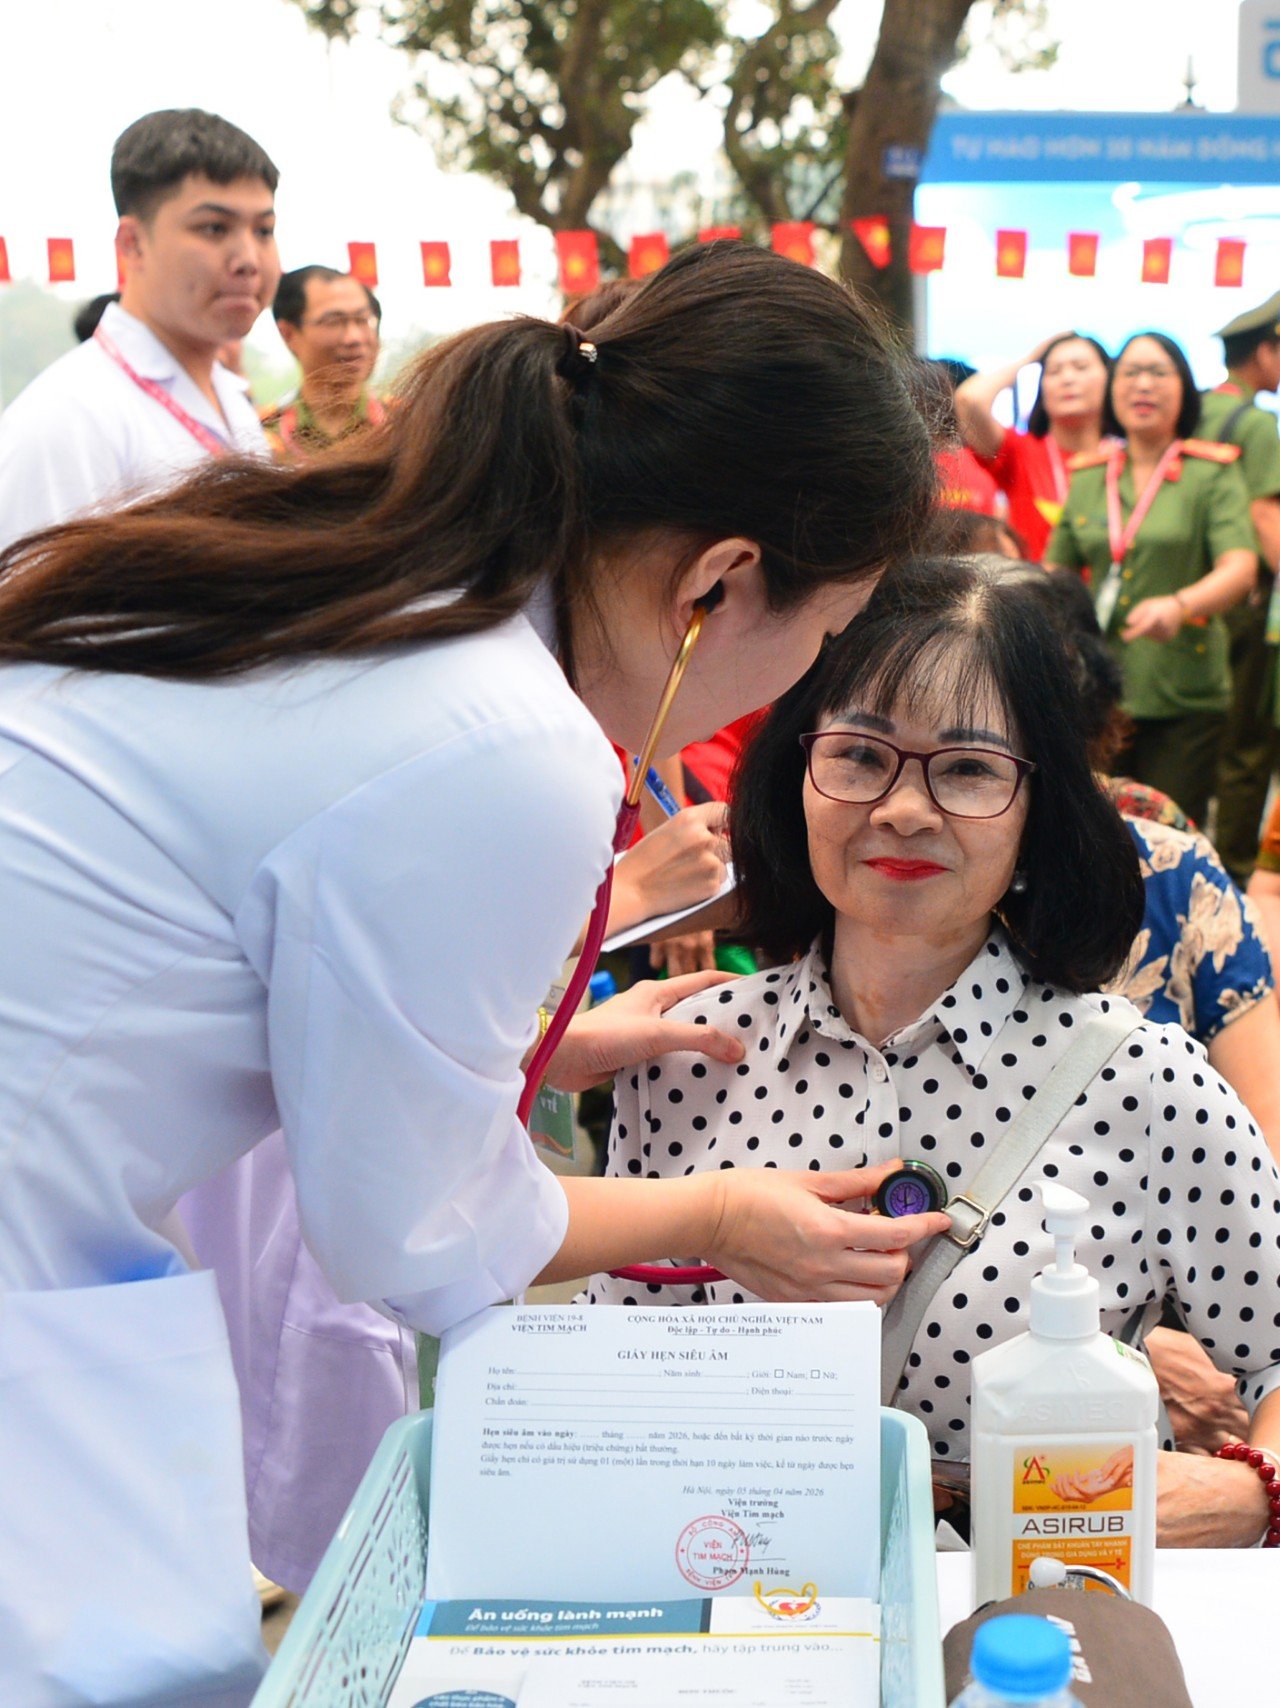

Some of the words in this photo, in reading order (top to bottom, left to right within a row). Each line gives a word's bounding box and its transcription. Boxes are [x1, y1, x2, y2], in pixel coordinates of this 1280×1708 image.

[627, 1315, 655, 1326] CỘNG
[698, 1315, 716, 1325] HỘI
[775, 1316, 799, 1326] VIỆT
[801, 1317, 823, 1325] NAM
[536, 1324, 555, 1332] TIM
[558, 1324, 587, 1333] MẠCH
[651, 1351, 675, 1362] HẸN
[679, 1350, 705, 1360] SIÊU
[709, 1350, 728, 1360] ÂM
[804, 1488, 824, 1496] 2026
[728, 1498, 747, 1508] Viện
[721, 1509, 740, 1519] Viện
[742, 1509, 760, 1518] Tim
[762, 1510, 785, 1519] mạch
[1022, 1516, 1124, 1534] ASIRUB
[704, 1539, 722, 1550] VIỆN
[501, 1608, 553, 1623] uống
[558, 1610, 601, 1620] lành
[606, 1608, 663, 1621] mạnh
[613, 1645, 641, 1654] tim
[761, 1643, 800, 1653] trung
